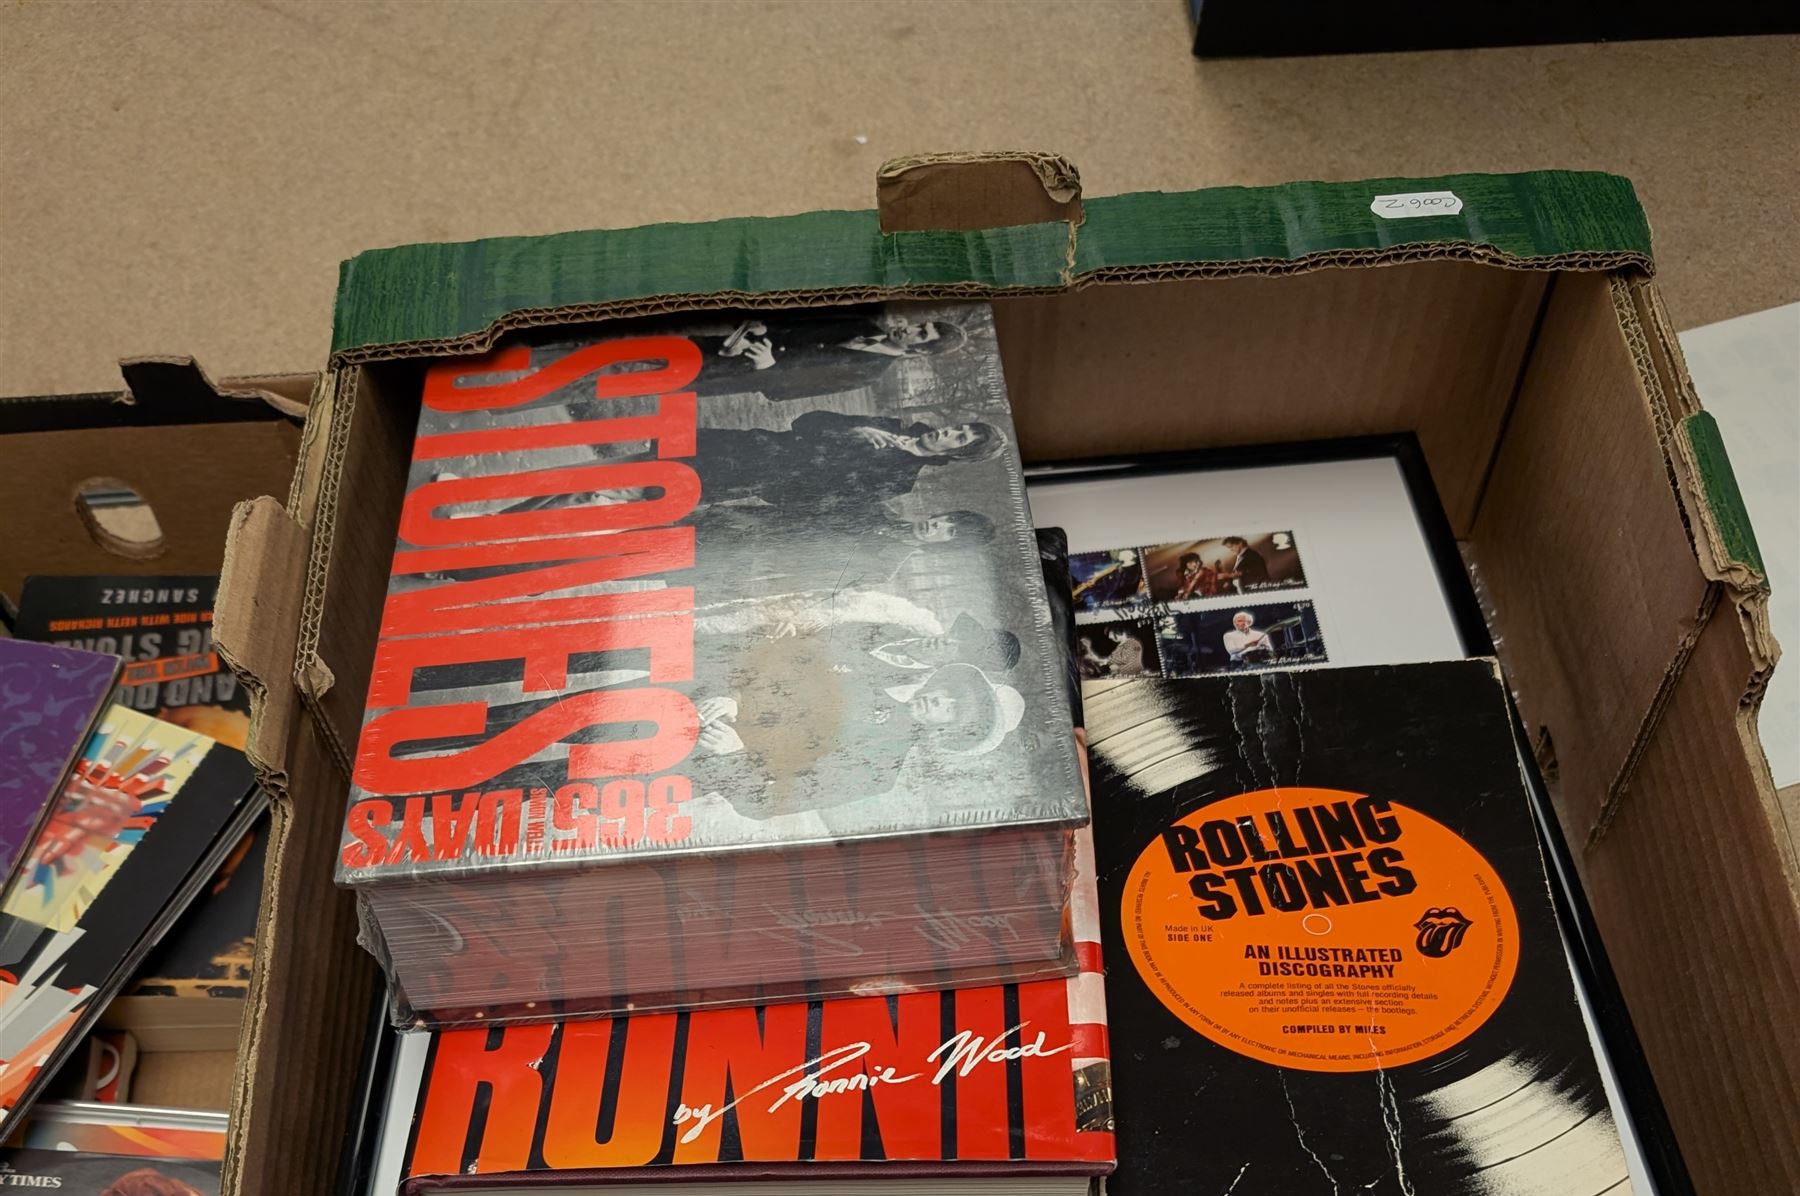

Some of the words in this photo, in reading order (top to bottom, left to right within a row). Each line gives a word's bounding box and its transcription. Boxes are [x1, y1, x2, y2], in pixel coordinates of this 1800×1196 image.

[352, 334, 704, 796] STONES
[100, 588, 198, 604] SANCHEZ
[552, 774, 693, 851] 365
[1160, 796, 1402, 874] ROLLING
[1188, 846, 1418, 921] STONES
[1164, 924, 1188, 932] Made
[1190, 924, 1198, 932] in
[1201, 924, 1214, 932] UK
[1167, 933, 1190, 942] SIDE
[1193, 933, 1213, 942] ONE
[1244, 944, 1271, 960] AN
[1277, 946, 1403, 963] ILLUSTRATED
[1258, 961, 1395, 978] DISCOGRAPHY
[1220, 989, 1255, 998] released
[1256, 989, 1286, 998] albums
[1288, 989, 1304, 997] and
[1305, 989, 1335, 999] singles
[1336, 990, 1355, 998] with
[1356, 990, 1370, 998] full
[1371, 991, 1409, 1000] recording
[1411, 992, 1439, 1001] details
[1239, 982, 1246, 990] A
[1247, 982, 1285, 992] complete
[1286, 982, 1312, 992] listing
[1352, 983, 1380, 991] Stones
[1381, 984, 1416, 993] officially
[1248, 1006, 1259, 1014] on
[1260, 1005, 1280, 1013] their
[1281, 1005, 1320, 1013] unofficial
[1321, 1005, 1357, 1013] releases
[1300, 998, 1319, 1007] plus
[1374, 999, 1404, 1007] section
[1282, 1024, 1335, 1034] COMPILED
[1338, 1024, 1351, 1034] BY
[1355, 1025, 1387, 1035] MILES
[672, 1102, 736, 1145] by
[745, 1040, 923, 1114] Ronnie
[926, 1020, 1083, 1085] Wood
[10, 1174, 63, 1189] TIMES
